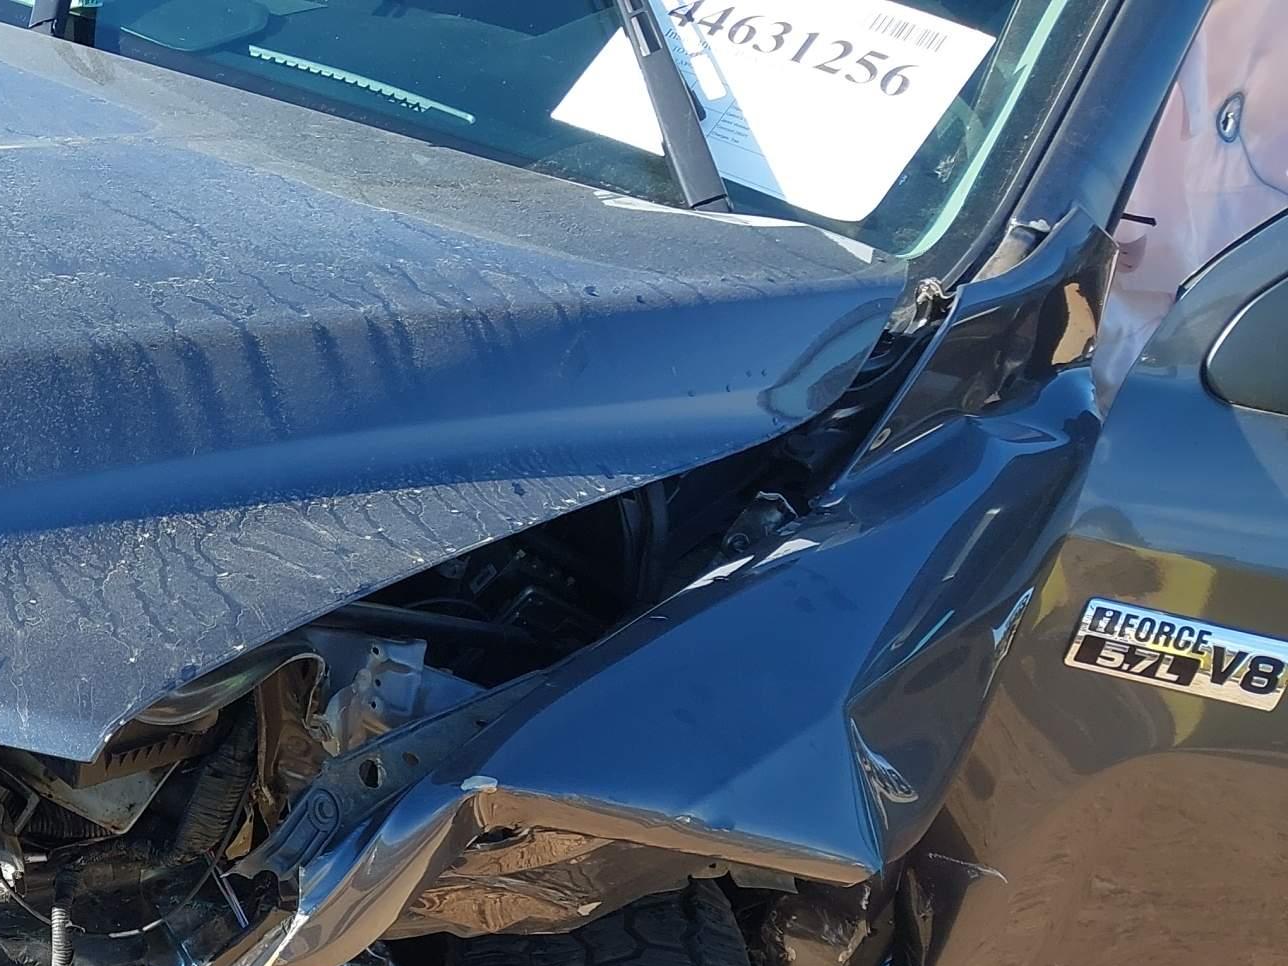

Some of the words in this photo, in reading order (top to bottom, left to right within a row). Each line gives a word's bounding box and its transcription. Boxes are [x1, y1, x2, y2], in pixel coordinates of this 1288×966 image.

[668, 0, 919, 96] 44631256
[1096, 641, 1180, 683] 5.7L
[1210, 645, 1285, 695] V8
